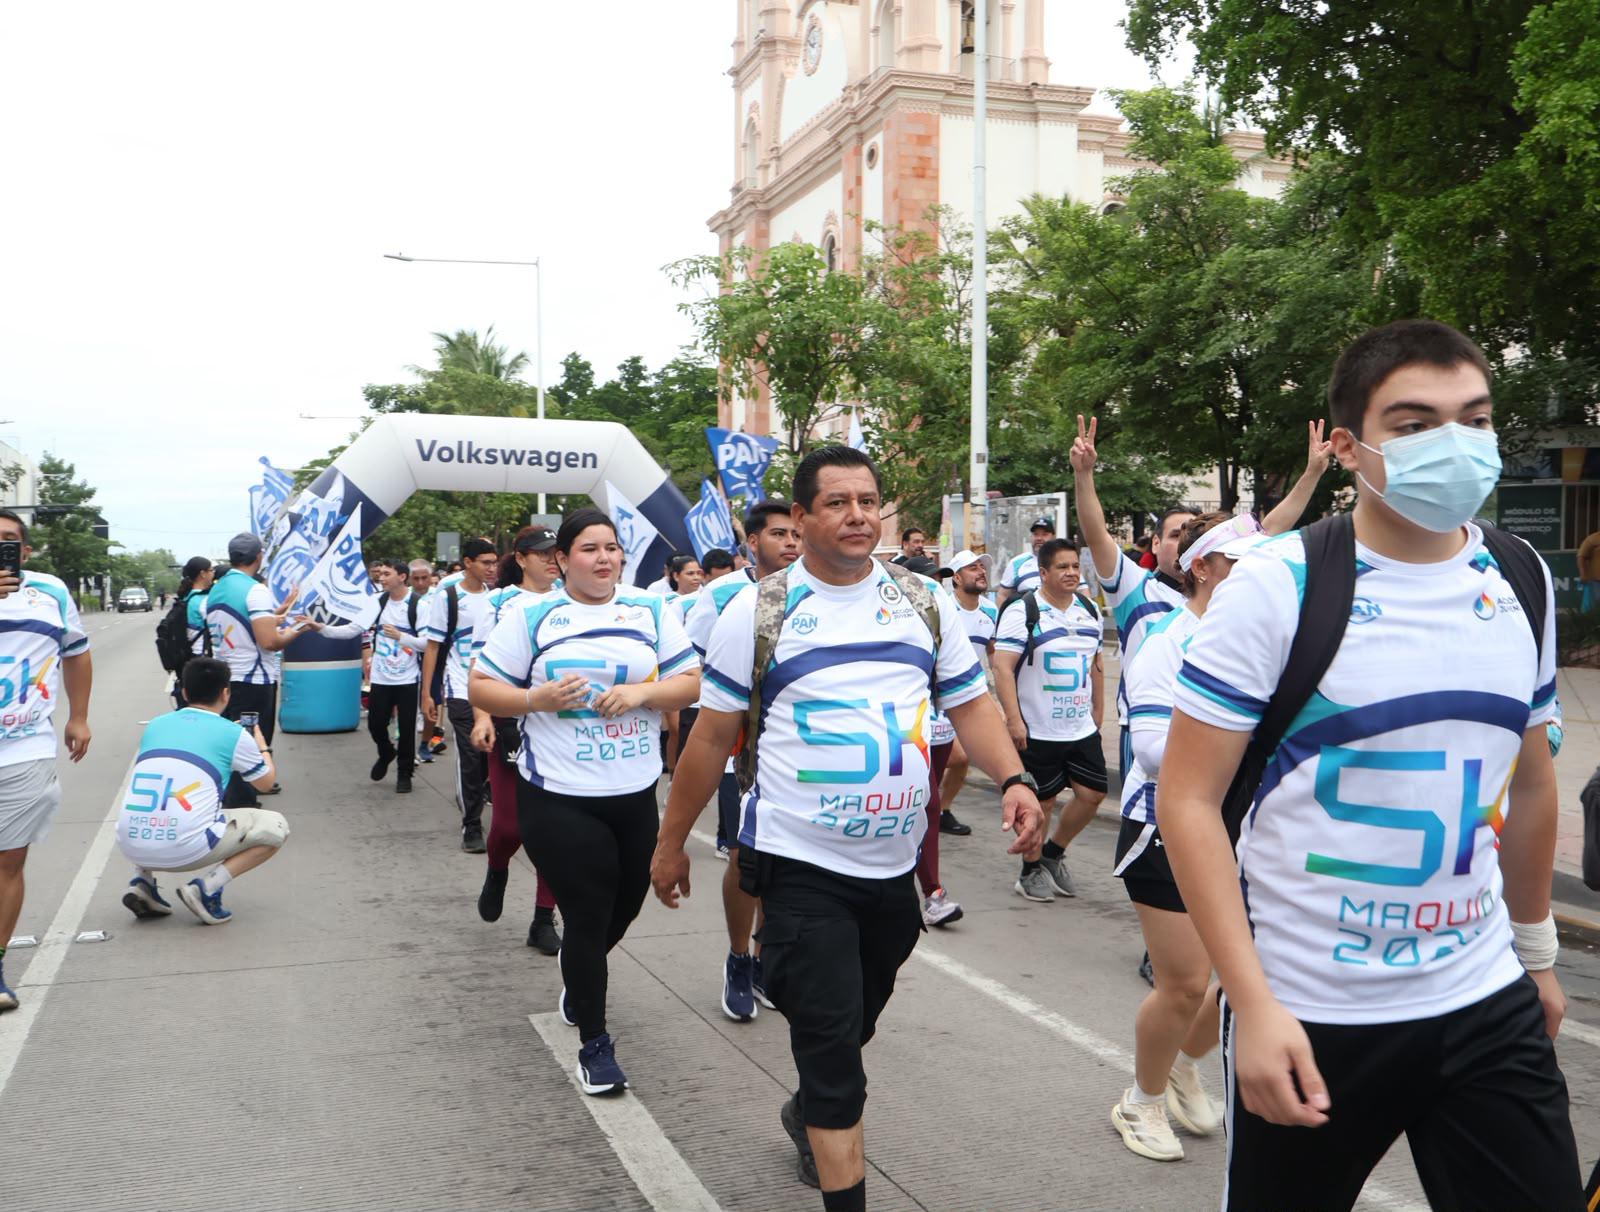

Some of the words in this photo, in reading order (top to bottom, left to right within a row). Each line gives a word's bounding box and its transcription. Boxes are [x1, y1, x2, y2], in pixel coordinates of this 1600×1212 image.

[415, 438, 598, 473] Volkswagen
[1543, 507, 1556, 515] DE
[549, 617, 570, 627] PAN
[791, 616, 818, 629] PAN
[575, 736, 650, 762] 2026
[128, 826, 177, 840] 2026
[1333, 927, 1481, 967] 202
